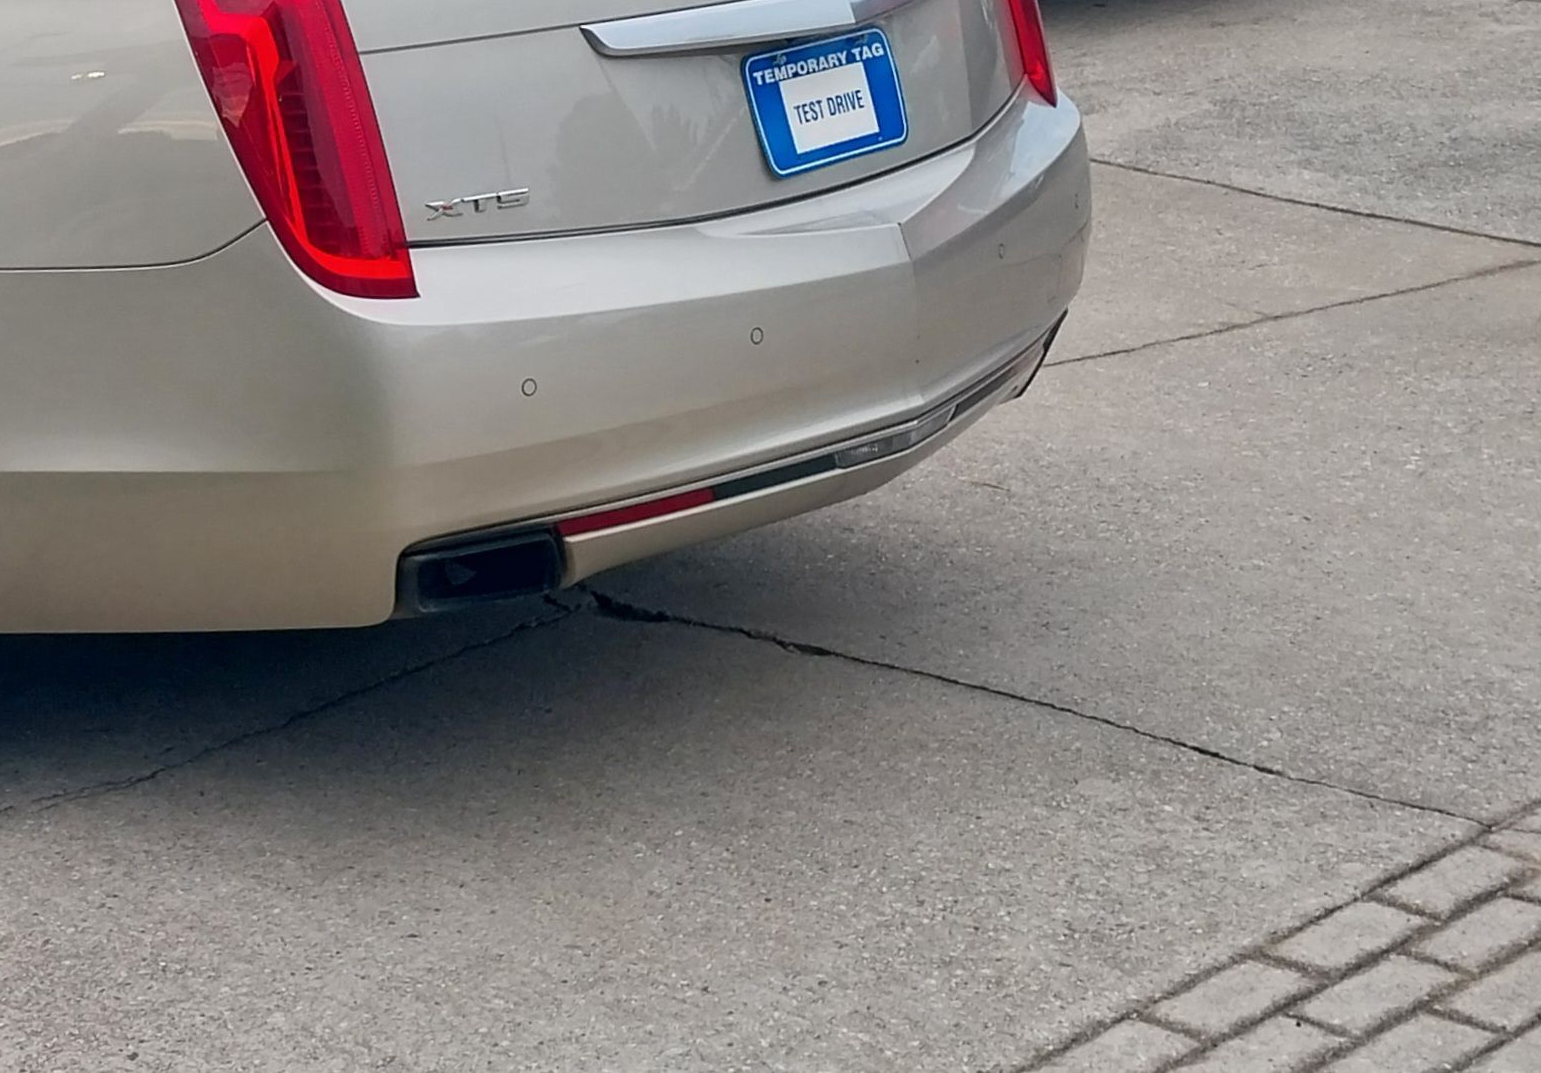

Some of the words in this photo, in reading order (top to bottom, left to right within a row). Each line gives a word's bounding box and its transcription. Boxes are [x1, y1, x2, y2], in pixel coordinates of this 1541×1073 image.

[752, 50, 848, 86] TEMPORARY
[851, 42, 885, 61] TAG
[793, 99, 825, 125] TEST
[827, 89, 865, 117] DRIVE
